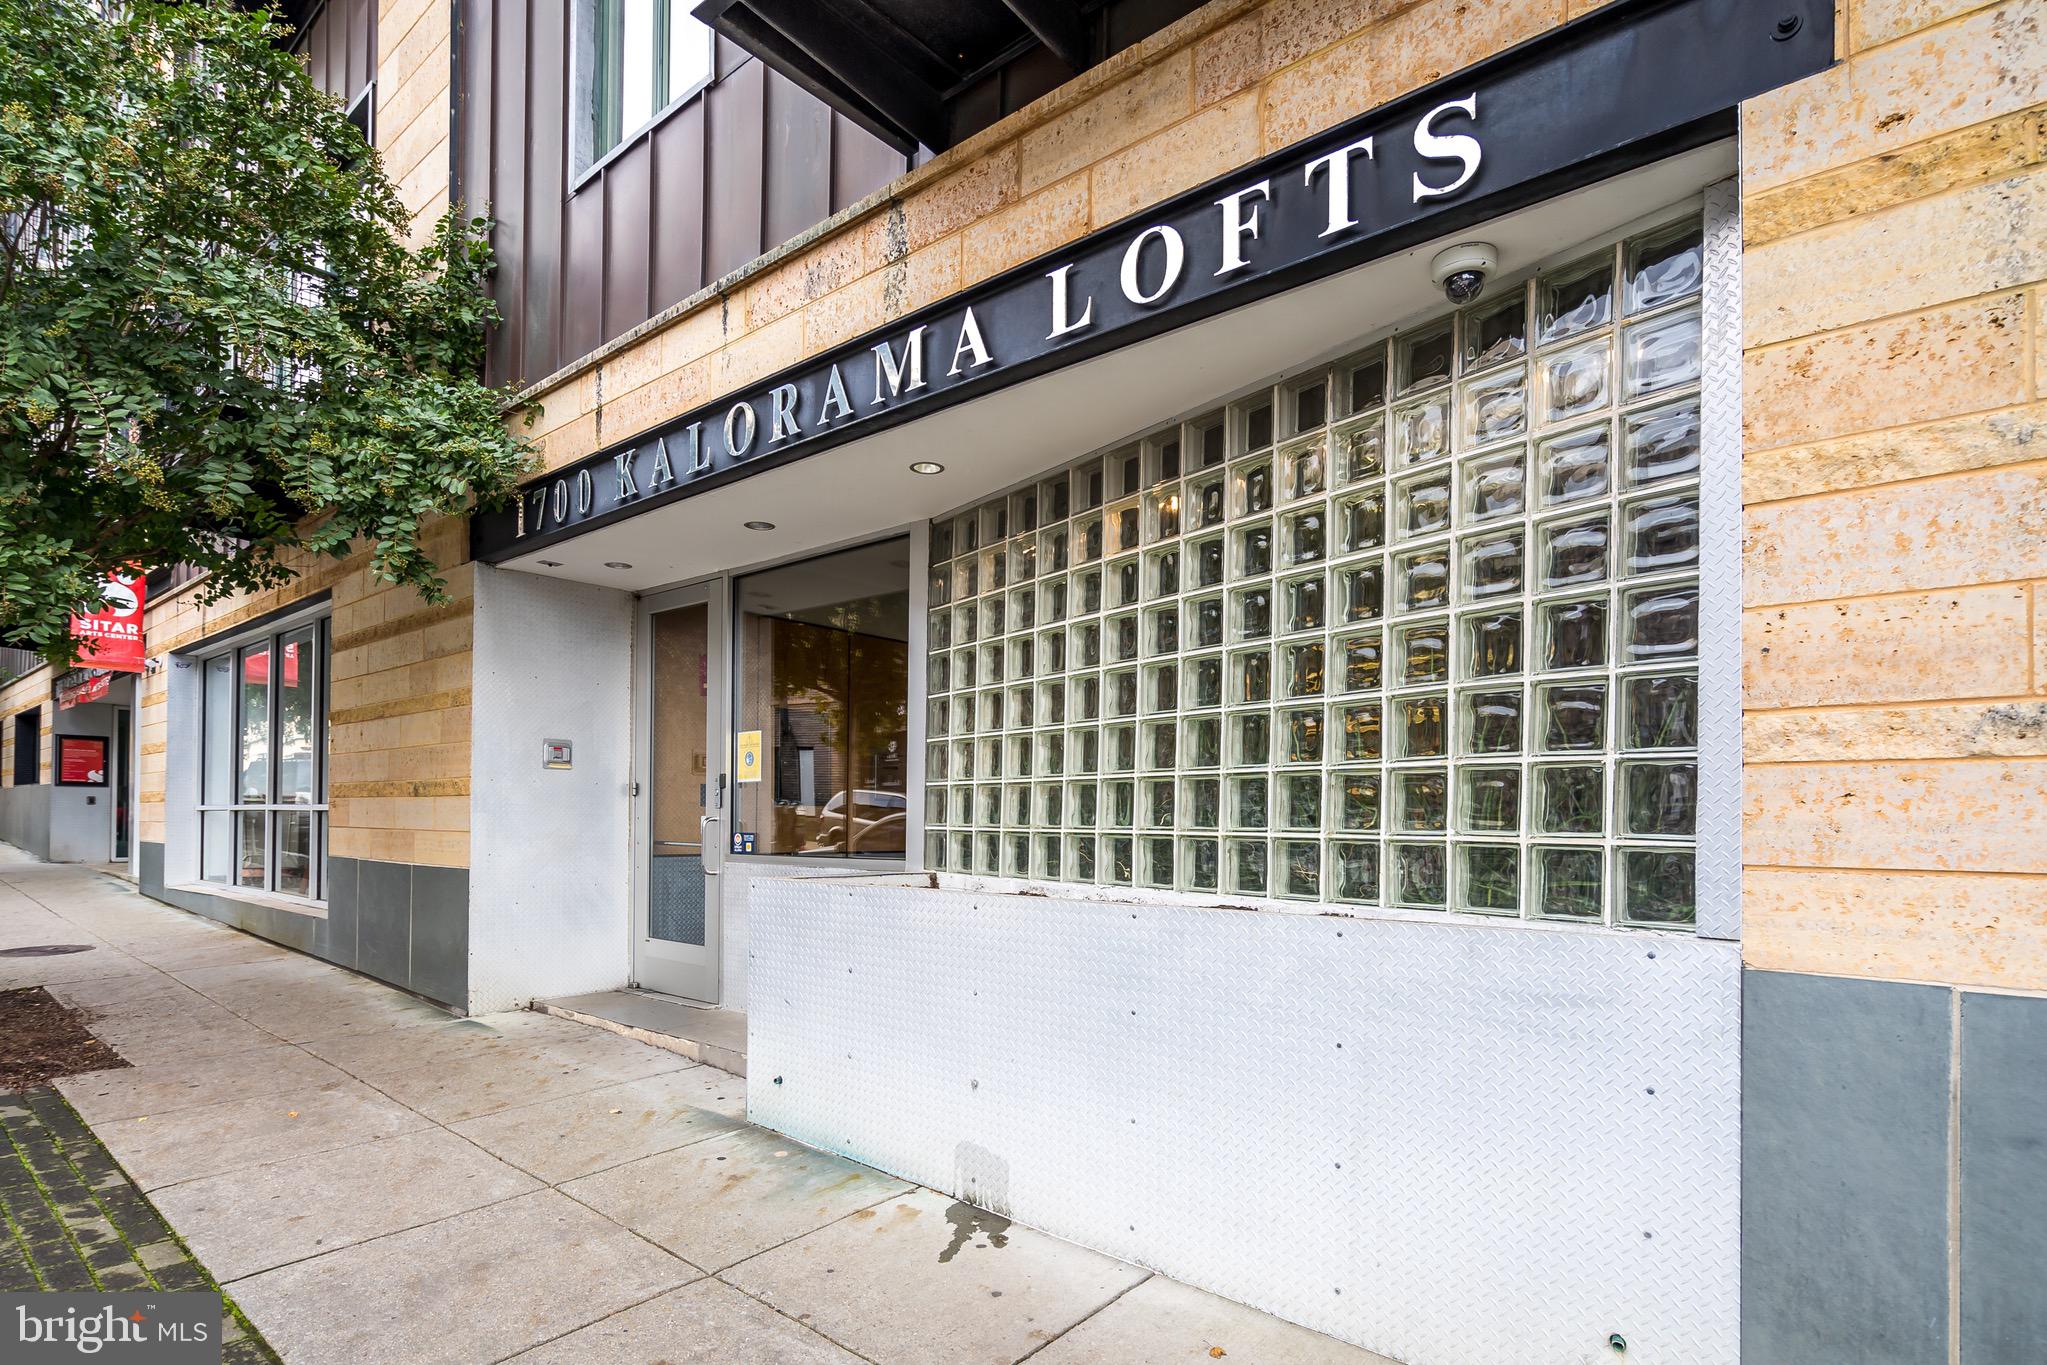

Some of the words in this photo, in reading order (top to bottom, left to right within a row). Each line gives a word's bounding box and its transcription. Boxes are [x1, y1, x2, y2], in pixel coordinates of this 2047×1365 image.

[515, 468, 591, 538] 1700
[613, 306, 993, 502] KALORAMA
[1045, 92, 1482, 340] LOFTS
[80, 619, 138, 635] SITAR
[104, 632, 138, 641] CENTER
